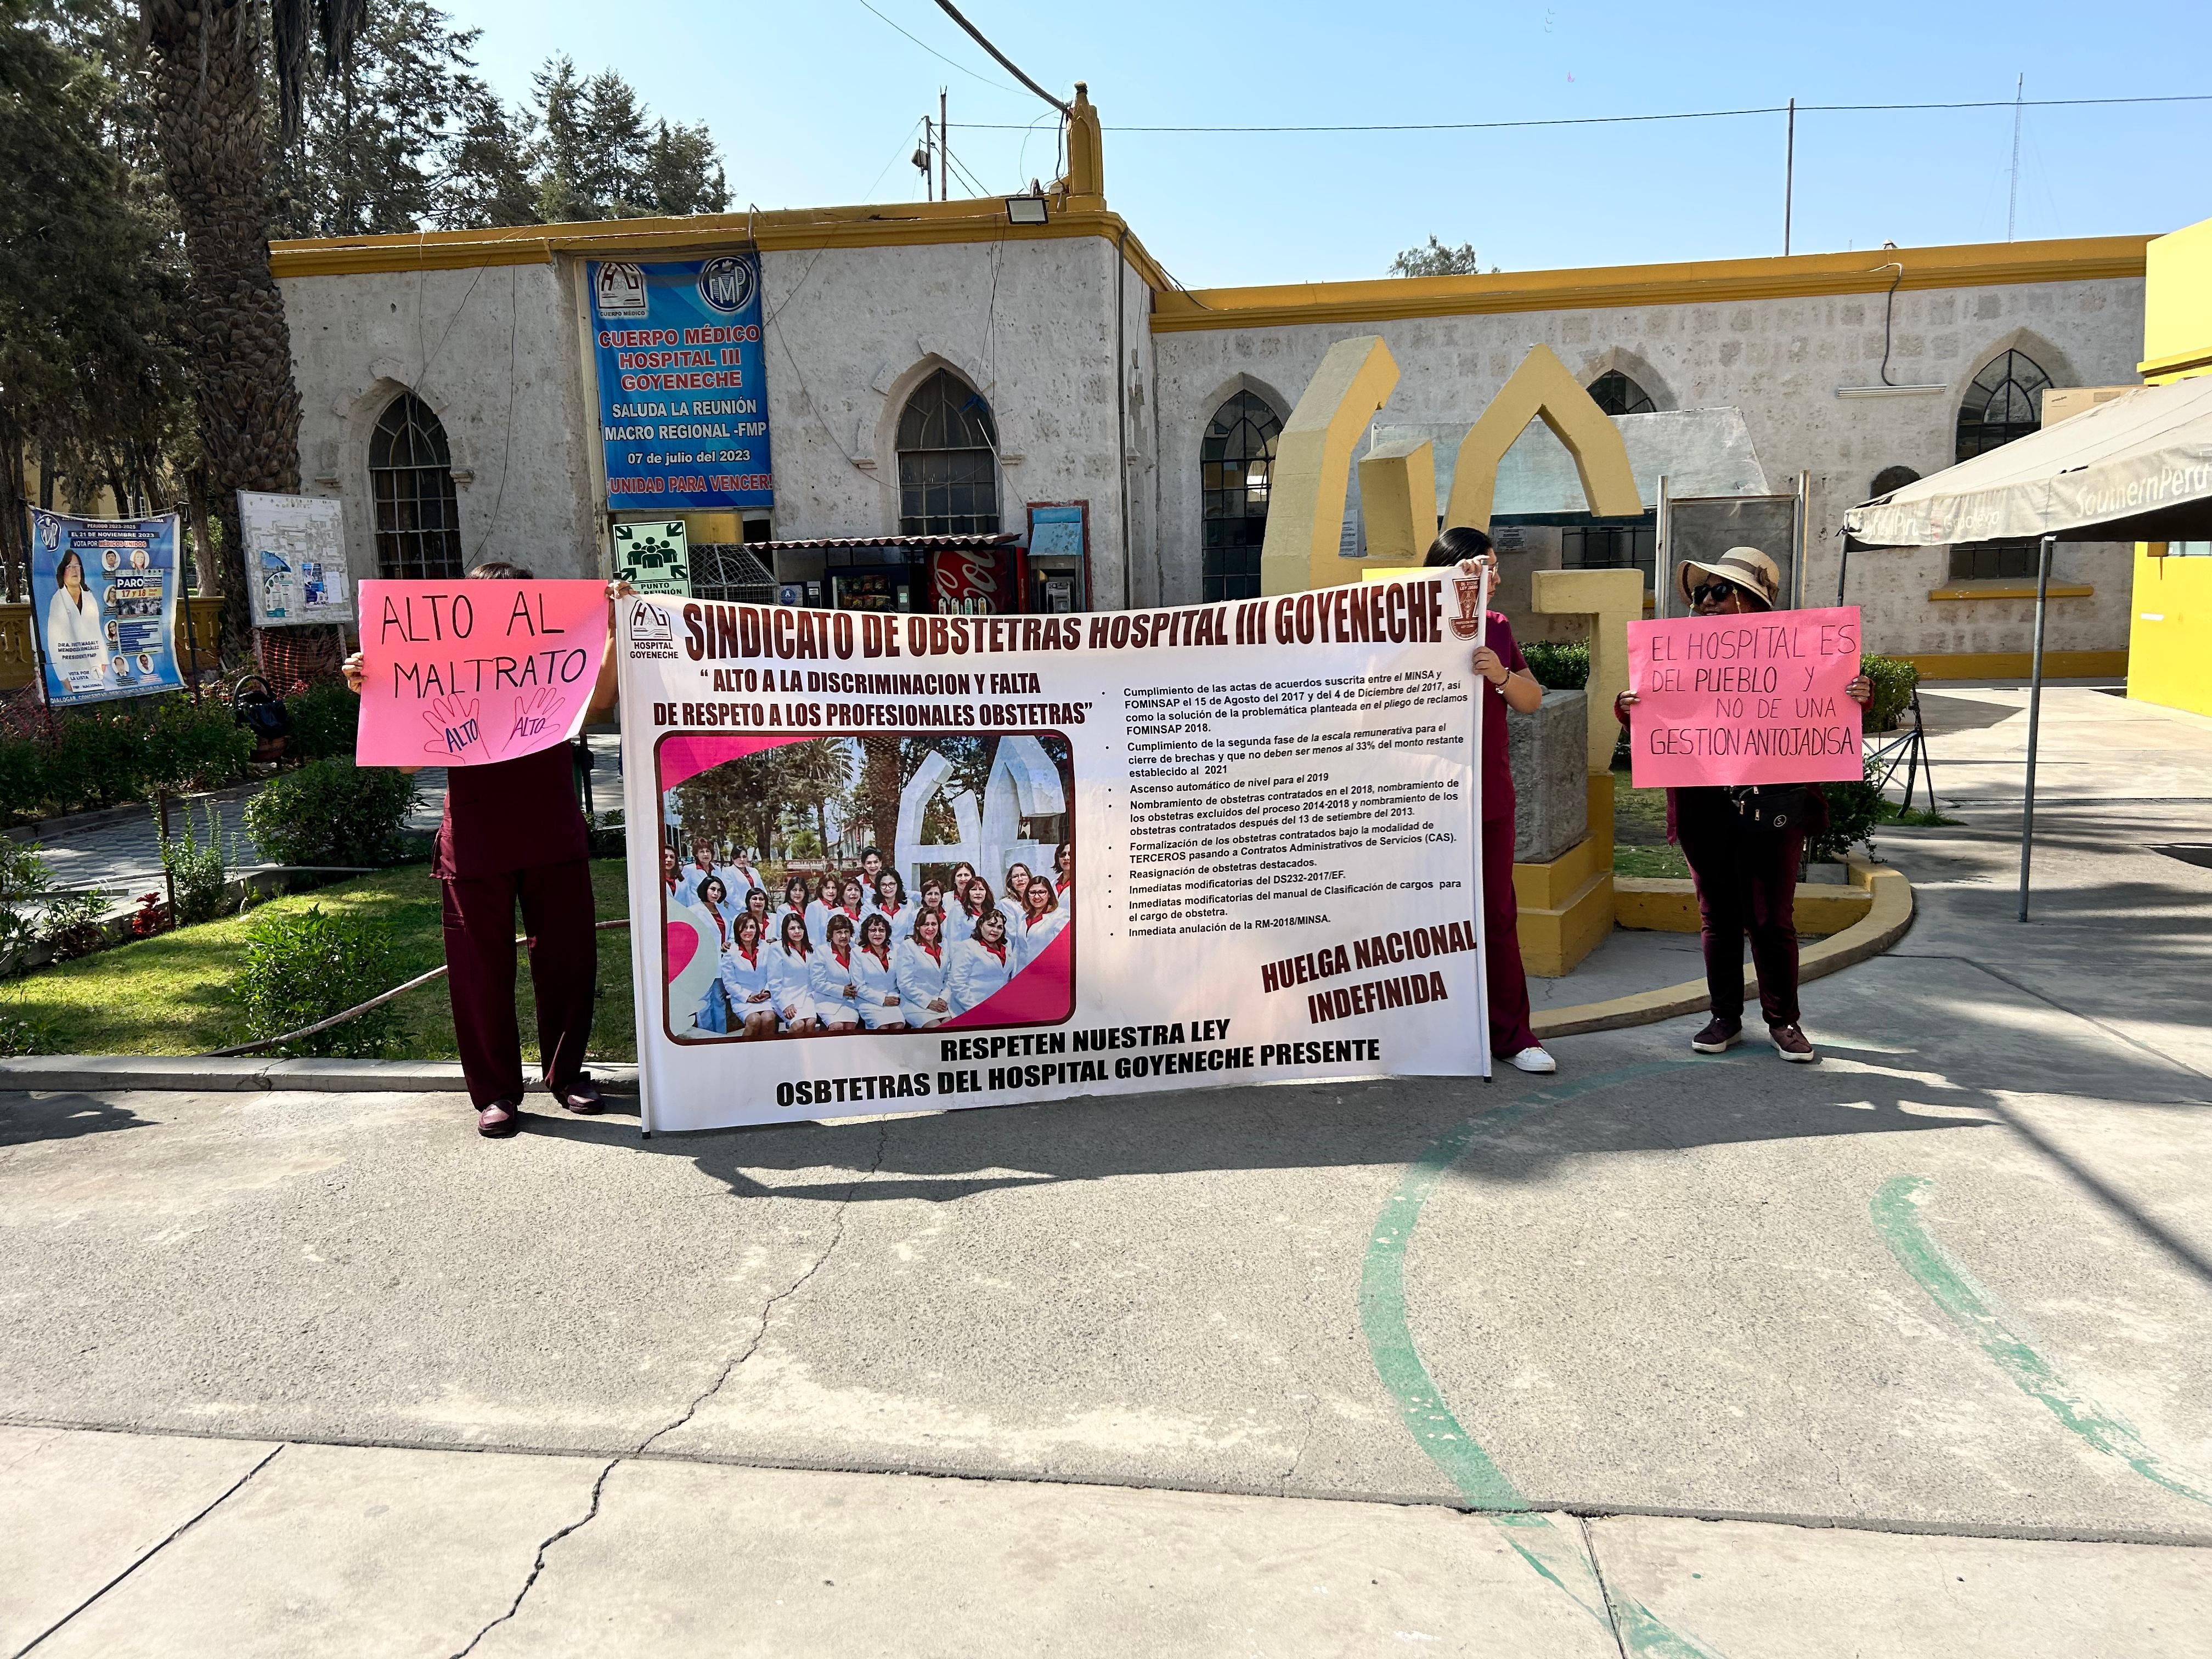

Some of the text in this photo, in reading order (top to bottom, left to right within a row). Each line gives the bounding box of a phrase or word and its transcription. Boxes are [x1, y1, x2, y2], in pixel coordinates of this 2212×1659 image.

[599, 324, 760, 348] CUERPO MÉDICO
[619, 348, 741, 369] HOSPITAL III
[621, 370, 742, 391] GOYENECHE
[612, 396, 757, 417] SALUDA LA REUNIÓN
[605, 426, 654, 440] MACRO
[659, 424, 730, 439] REGIONAL
[628, 450, 751, 466] 07 de julio del 2023
[669, 476, 707, 493] PARA
[710, 474, 772, 492] VENCER!
[117, 579, 144, 588] PARO
[382, 591, 565, 645] ALTO AL
[683, 580, 1442, 661] SINDICATO DE OBSTETRAS HOSPITAL III GOYENECHE
[1652, 624, 1857, 661] EL HOSPITAL ES
[394, 648, 586, 698] MALTRATO
[763, 669, 775, 692] A
[780, 670, 803, 691] LA
[808, 672, 970, 695] DISCRIMINACION
[974, 674, 985, 694] Y
[990, 673, 1041, 694] FALTA
[1124, 686, 1193, 697] Cumplimiento
[1275, 679, 1322, 689] acuerdos
[1325, 676, 1364, 686] suscrita
[1368, 675, 1391, 683] entre
[1394, 673, 1402, 681] el
[1405, 670, 1434, 680] MINSA
[1436, 672, 1442, 680] y
[1652, 669, 1685, 692] DEL
[1695, 666, 1778, 693] PUEBLO
[1125, 680, 1460, 709] FOMINSAP el 15 de Agosto del 2017 y del 4 de Diciembre del 2017, así
[654, 703, 678, 725] DE
[682, 703, 764, 726] RESPETO
[769, 704, 782, 726] A
[786, 703, 821, 726] LOS
[827, 703, 974, 726] PROFESIONALES
[1716, 697, 1836, 719] NO DE UNA
[445, 718, 479, 753] ALTO
[511, 716, 546, 738] ALTO
[1650, 727, 1854, 756] GESTION ANTOJADISA
[1130, 765, 1226, 777] establecido al 2021
[1130, 867, 1194, 879] Reasignación
[1212, 863, 1256, 872] obstetras
[1260, 859, 1317, 869] destacados.
[1130, 871, 1345, 894] Inmediatas modificatorias del DS232-2017/EF.
[1129, 909, 1227, 922] el cargo de obstetra.
[1130, 927, 1176, 936] Inmediata
[1180, 923, 1226, 933] anulación
[1244, 921, 1252, 929] la
[1256, 915, 1330, 928] RM-2018/MINSA.
[1261, 920, 1477, 993] HUELGA NACIONAL
[1307, 971, 1448, 1024] INDEFINIDA
[941, 1018, 1231, 1061] RESPETEN NUESTRA LEY
[777, 1039, 1380, 1107] OSBTETRAS DEL HOSPITAL GOYENECHE PRESENTE
